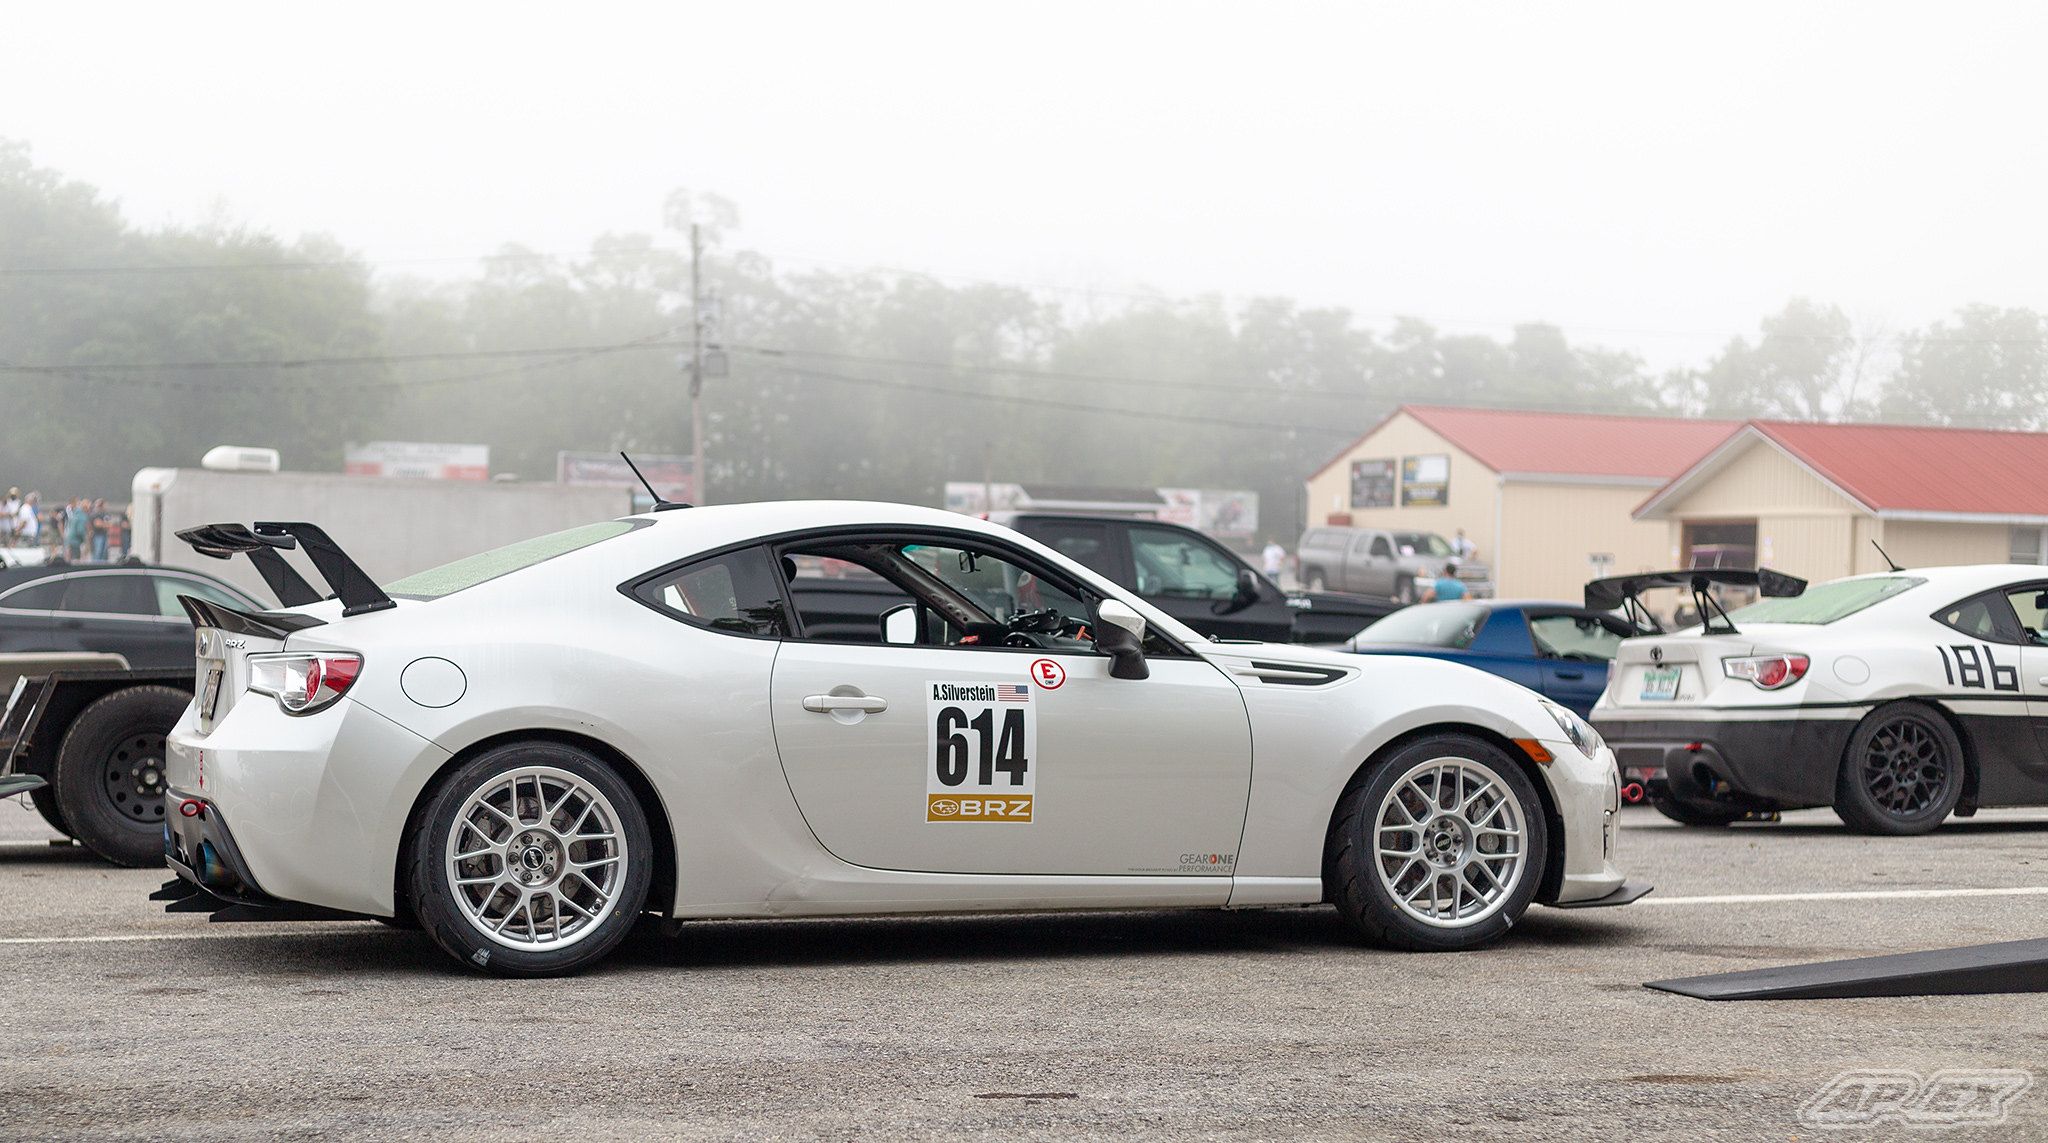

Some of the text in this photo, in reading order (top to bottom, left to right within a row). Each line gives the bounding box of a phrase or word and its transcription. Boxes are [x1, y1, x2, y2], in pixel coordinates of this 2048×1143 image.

[1041, 663, 1056, 679] E
[1936, 645, 2019, 692] 186
[933, 684, 996, 702] A.Silverstein
[936, 706, 1028, 787] 614
[960, 799, 1031, 816] BRZ
[1180, 854, 1233, 864] GEARONE
[1179, 865, 1232, 873] PERFORMANCE
